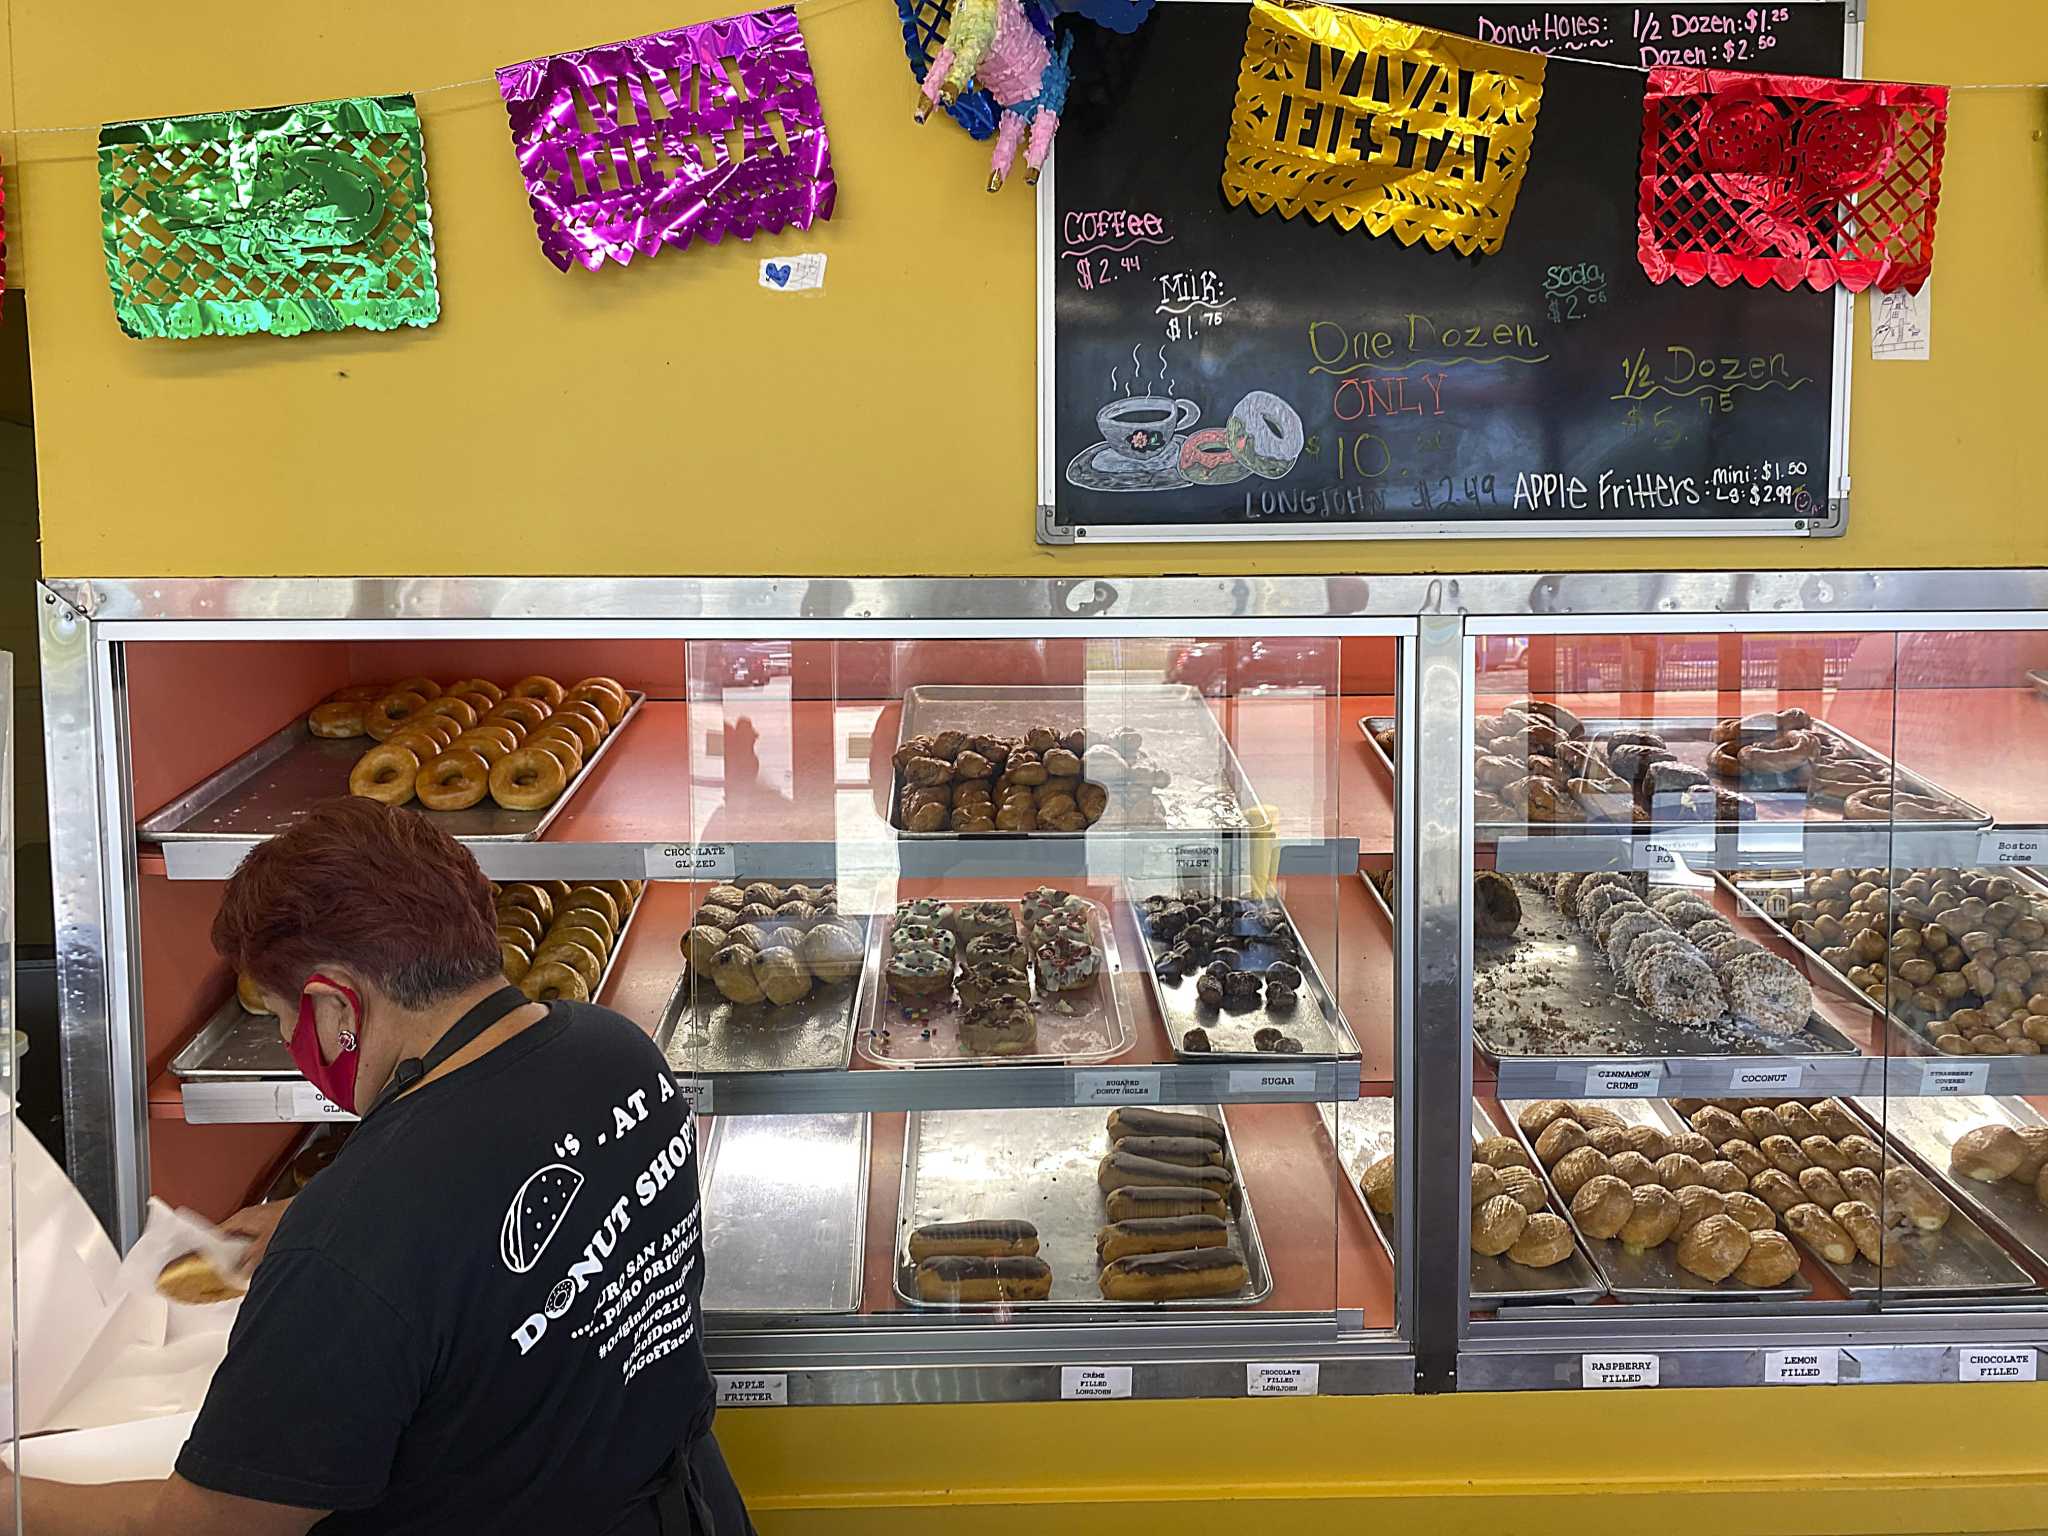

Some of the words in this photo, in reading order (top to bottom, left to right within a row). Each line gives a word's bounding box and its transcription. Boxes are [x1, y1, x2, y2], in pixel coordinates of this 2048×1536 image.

[1478, 16, 1541, 44] Donut
[1632, 9, 1663, 43] 1/2
[1671, 14, 1743, 37] Dozen:
[1744, 8, 1790, 34] $1.25
[1722, 35, 1777, 63] $2.50
[1309, 42, 1470, 120] VIVA
[1280, 93, 1488, 182] FIESTA
[1076, 255, 1141, 291] $2.44
[1166, 312, 1223, 342] $1.75
[1308, 320, 1394, 365] One
[1403, 312, 1539, 351] Dozen
[1621, 347, 1655, 396] 1/2
[1664, 346, 1789, 384] Dozen
[1333, 372, 1448, 421] ONLY
[1761, 460, 1808, 481] $1.50
[1749, 483, 1792, 506] $2.99
[1998, 841, 2038, 850] Boston
[1176, 859, 1209, 867] TWIST
[1261, 1077, 1295, 1086] SUGAR
[1598, 1070, 1650, 1078] CINNAMON
[1741, 1074, 1787, 1083] COCONUT
[612, 1088, 649, 1139] AT
[657, 1072, 675, 1103] A
[626, 1241, 655, 1279] SAN
[643, 1226, 700, 1285] ORIGINAL
[1592, 1362, 1651, 1371] RASPBERRY
[1784, 1356, 1817, 1365] LEMON
[1970, 1355, 2029, 1364] CHOCOLATE
[1602, 1374, 1641, 1383] FILLED
[1781, 1368, 1820, 1377] FILLED
[1980, 1367, 2019, 1376] FILLED
[730, 1380, 765, 1389] APPLE
[724, 1392, 773, 1401] FRITTER
